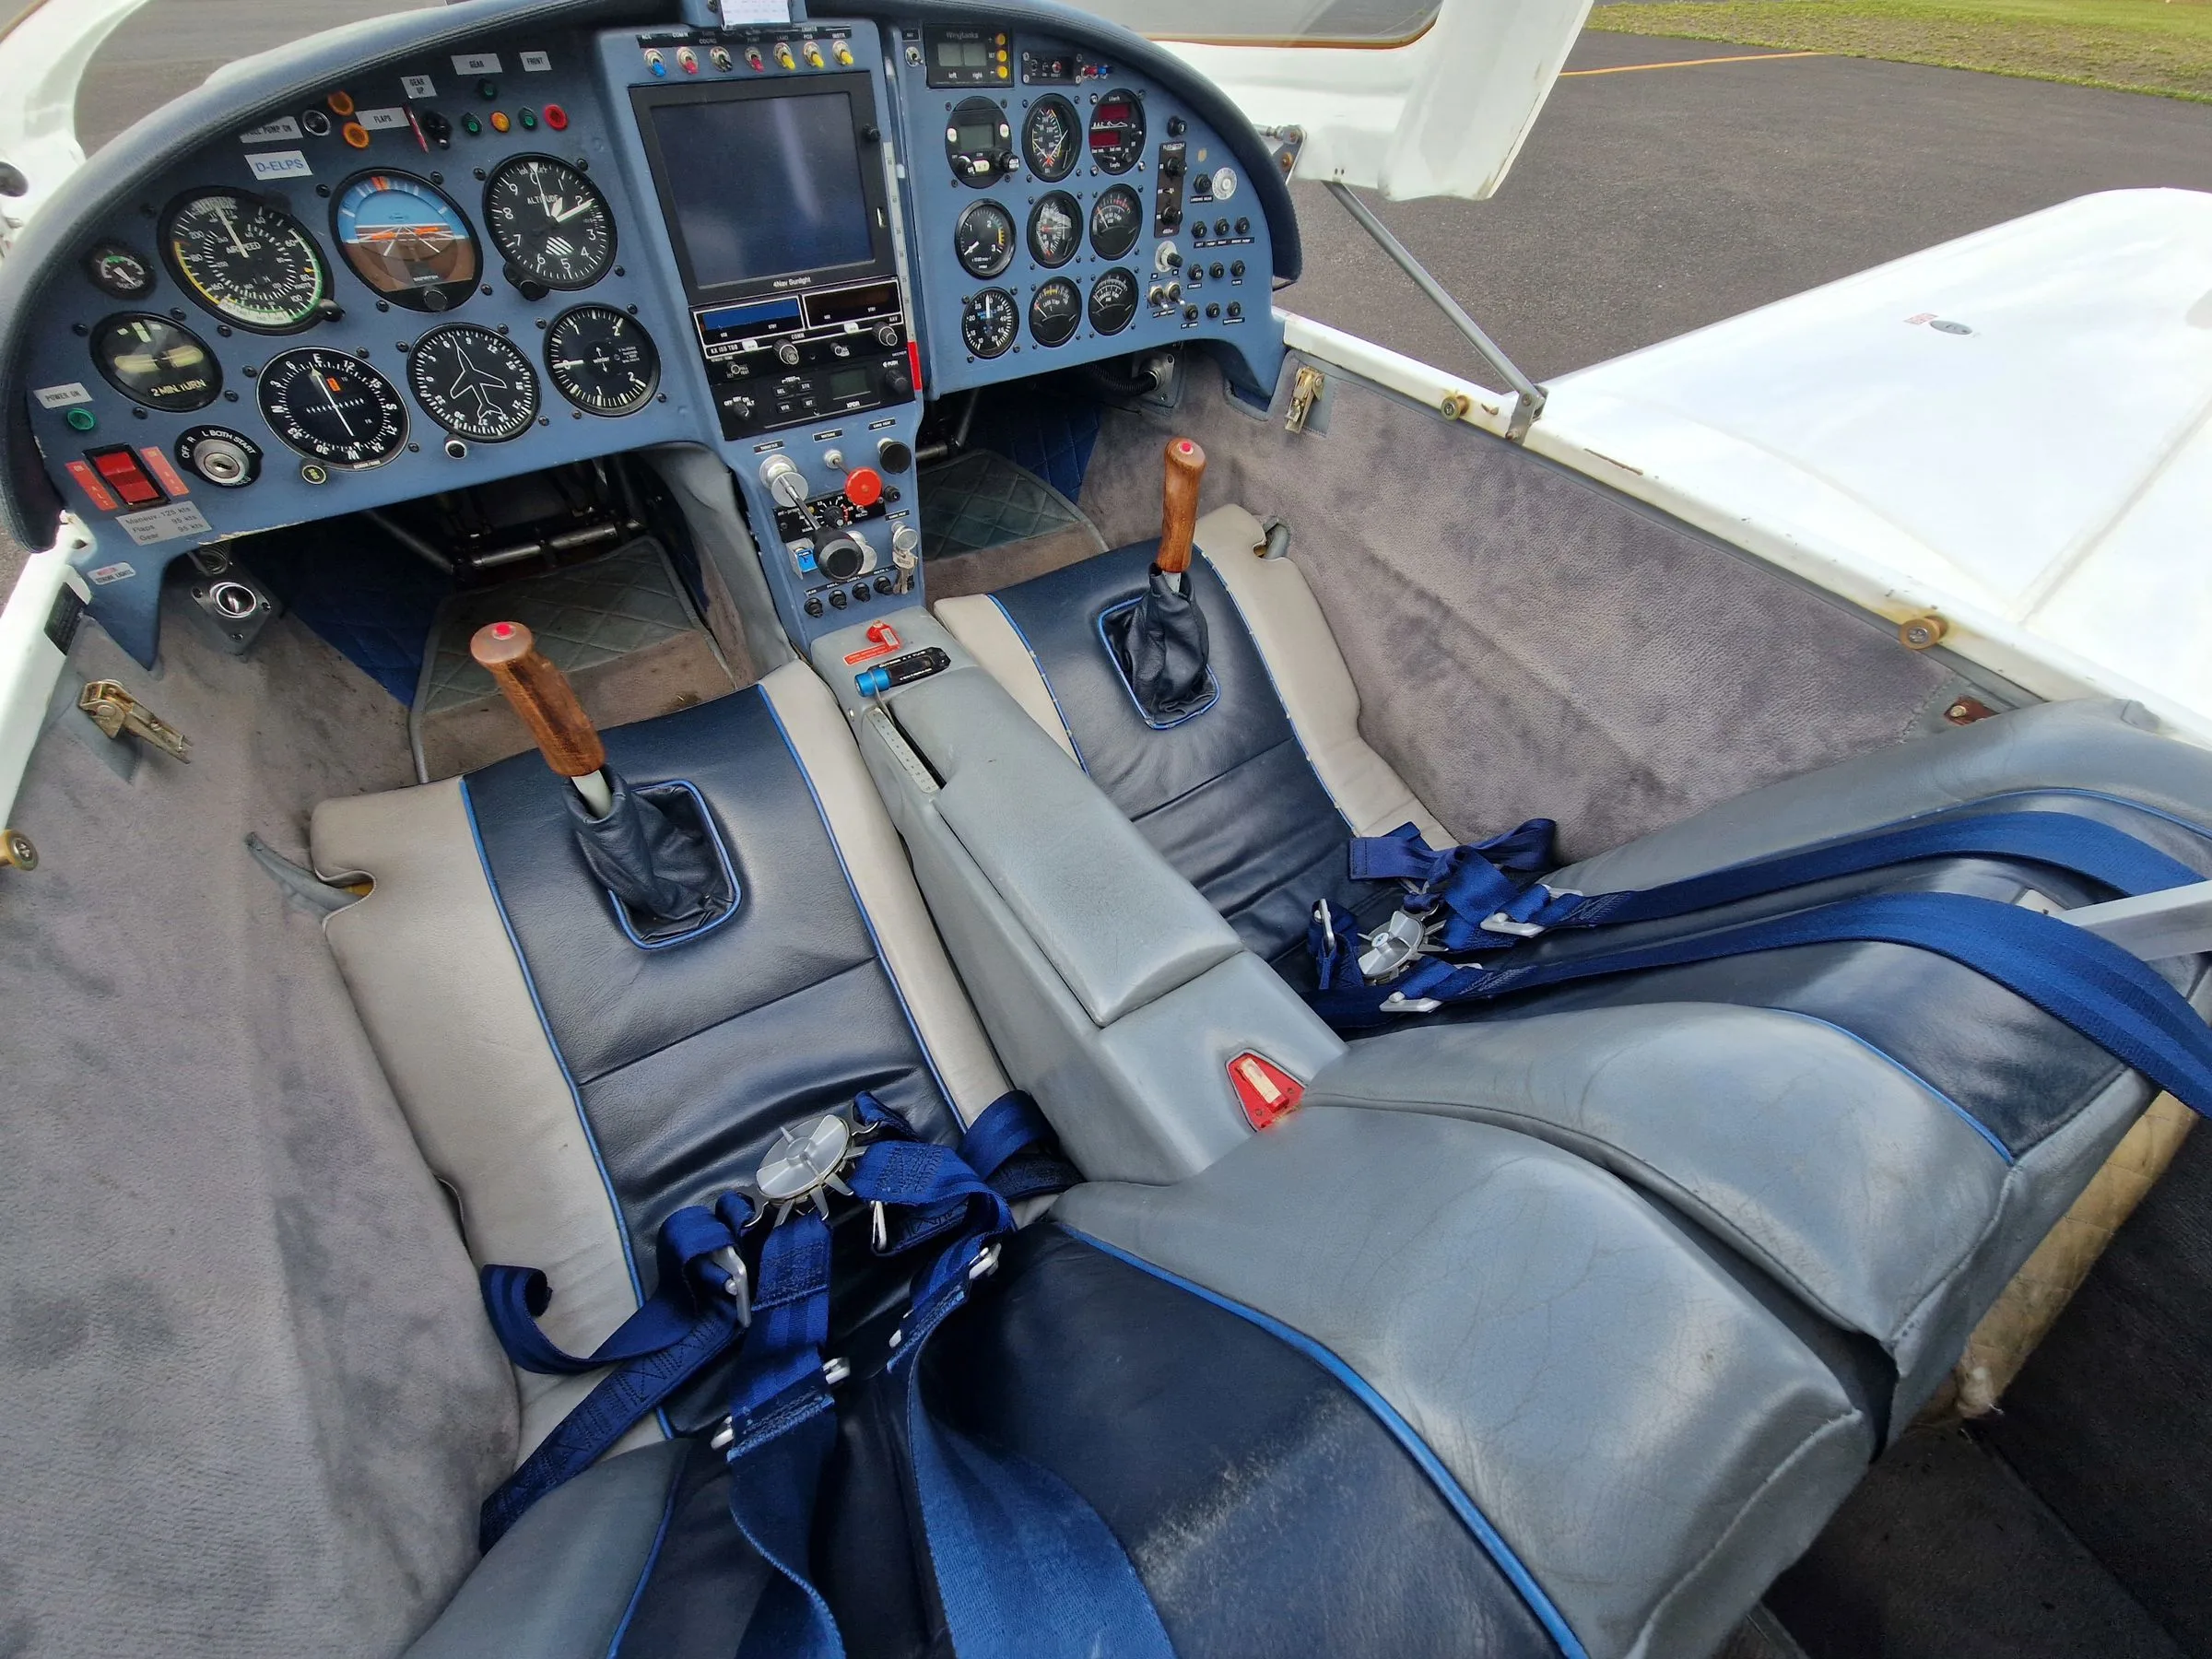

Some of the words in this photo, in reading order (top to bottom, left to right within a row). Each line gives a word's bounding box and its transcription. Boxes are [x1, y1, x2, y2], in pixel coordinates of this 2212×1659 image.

[946, 31, 979, 40] Wingtanks
[469, 60, 484, 68] GEAR
[374, 115, 392, 124] FLAPS
[255, 159, 304, 172] D-ELPS
[509, 183, 518, 195] 9
[502, 207, 513, 219] 8
[189, 230, 204, 240] 200
[513, 234, 522, 245] 7
[586, 229, 596, 241] 3
[226, 241, 261, 254] AIRPEED
[285, 240, 295, 248] 60
[581, 246, 590, 257] 4
[537, 253, 546, 265] 6
[560, 258, 571, 269] 5
[788, 276, 811, 286] Sunlight
[290, 294, 303, 302] 100
[573, 324, 580, 335] 1
[612, 325, 620, 336] 2
[487, 344, 499, 354] 12
[312, 353, 322, 364] E
[286, 361, 296, 371] 6
[343, 360, 356, 371] 12
[505, 361, 516, 370] 15
[628, 371, 635, 382] 2
[151, 388, 160, 396] 2
[180, 379, 206, 392] TURN
[370, 378, 382, 389] 15
[596, 386, 603, 395] 1
[44, 394, 70, 402] POWER
[270, 406, 284, 414] N
[512, 400, 522, 409] 21
[454, 411, 465, 420] 30
[209, 429, 232, 440] BOTH
[288, 428, 301, 439] 33
[233, 436, 257, 454] START
[316, 445, 330, 455] 30
[371, 442, 384, 453] 24
[182, 445, 190, 458] OFF
[347, 451, 359, 460] W
